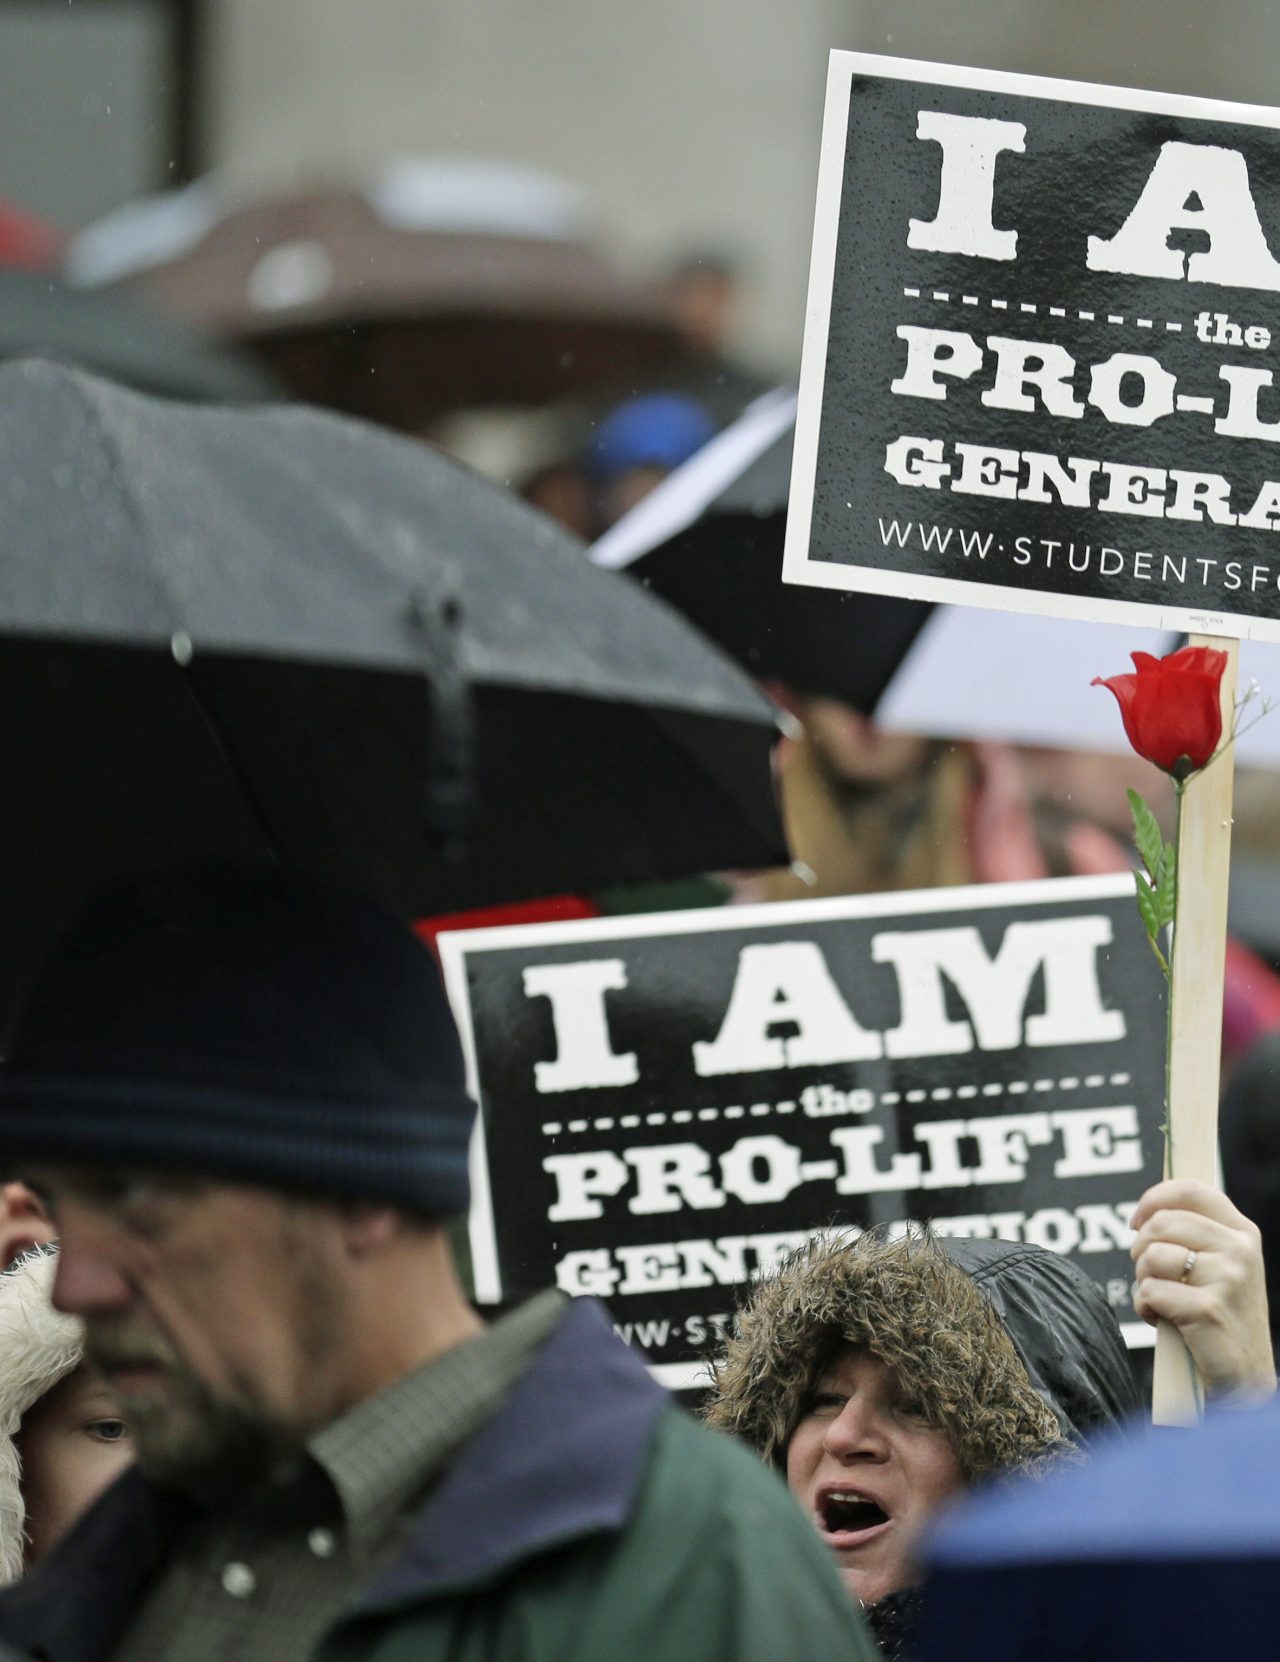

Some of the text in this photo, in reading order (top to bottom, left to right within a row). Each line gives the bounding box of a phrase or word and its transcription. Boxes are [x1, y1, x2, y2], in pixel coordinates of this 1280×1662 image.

[906, 110, 1027, 262] I
[1193, 311, 1272, 350] the
[522, 914, 1128, 1093] I AM
[800, 1084, 876, 1118] the
[542, 1105, 1145, 1222] PRO-LIFE
